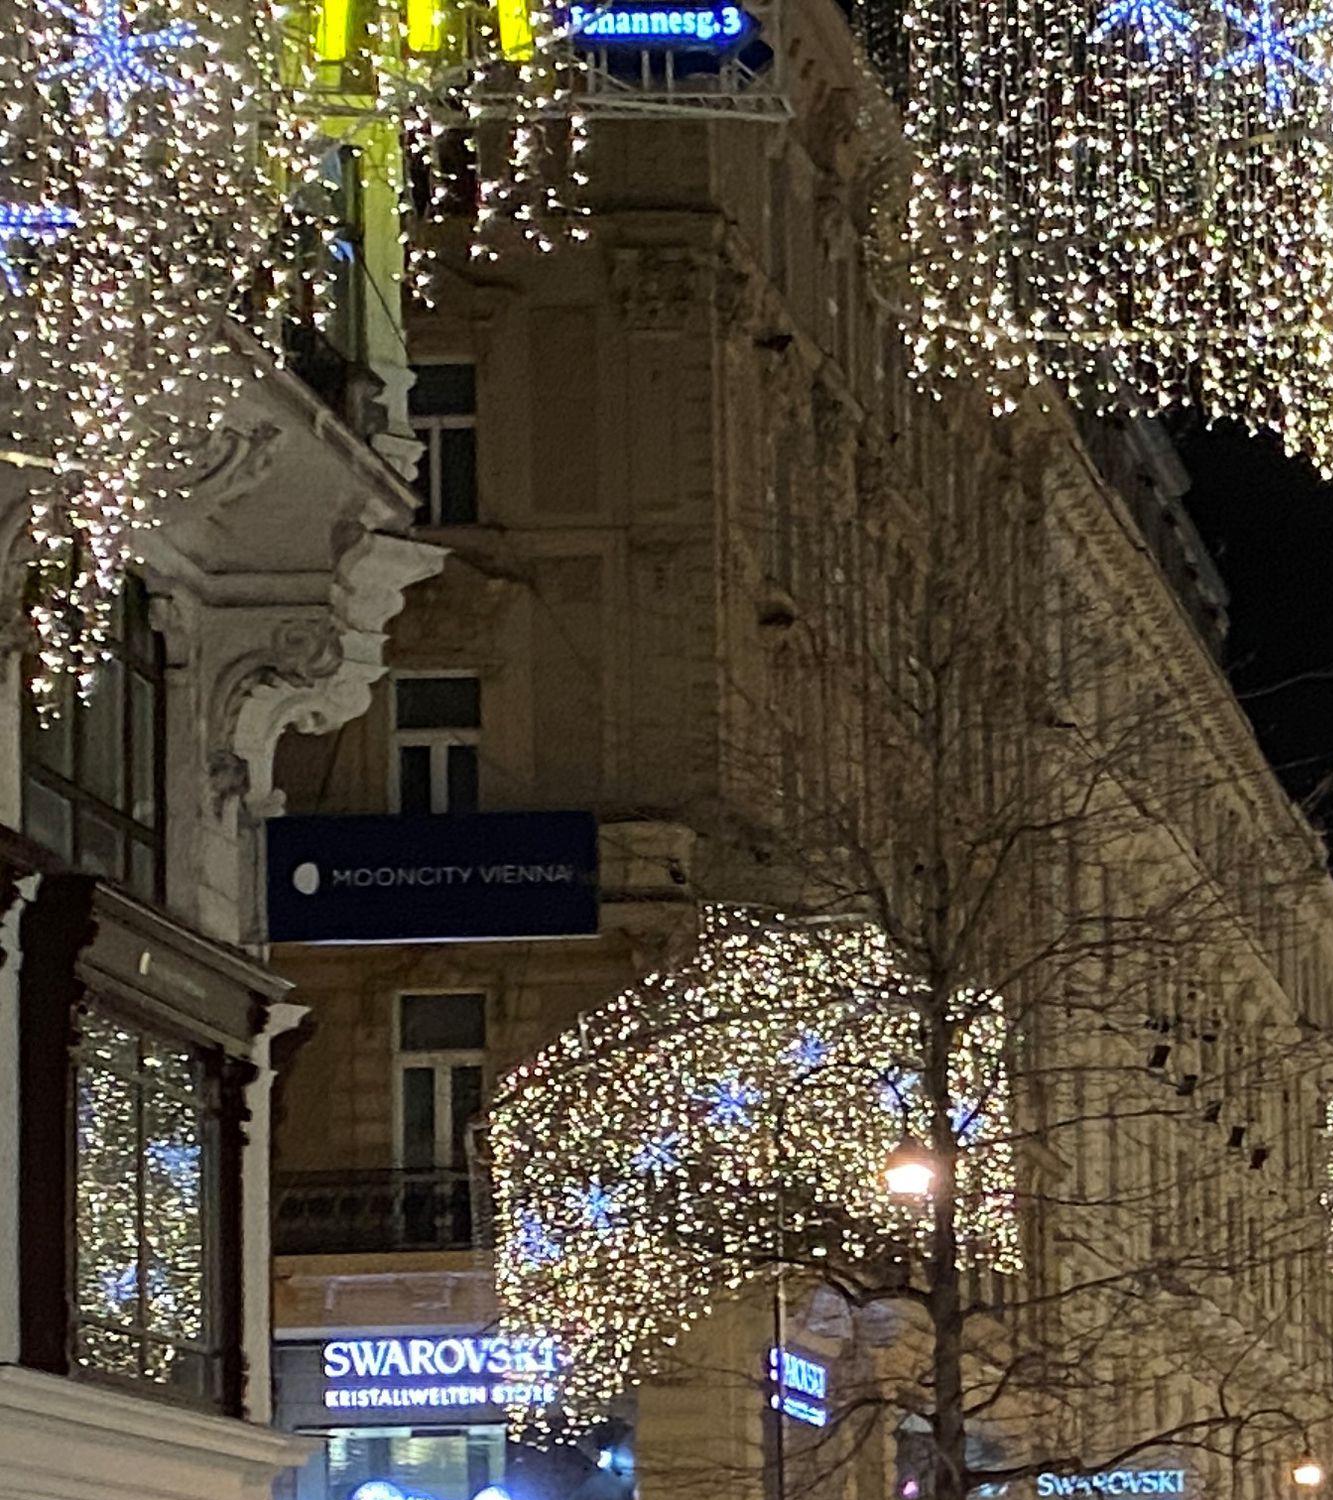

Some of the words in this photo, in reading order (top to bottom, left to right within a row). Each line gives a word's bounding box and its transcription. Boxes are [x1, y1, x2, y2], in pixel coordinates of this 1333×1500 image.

[332, 866, 472, 887] MOONCITY
[478, 863, 573, 884] VIENNA
[323, 1337, 557, 1378] SWAROVSKI
[324, 1386, 487, 1408] KRISTALLWELTEN
[491, 1382, 556, 1404] STORE
[1037, 1469, 1186, 1497] SWAROVSKI
